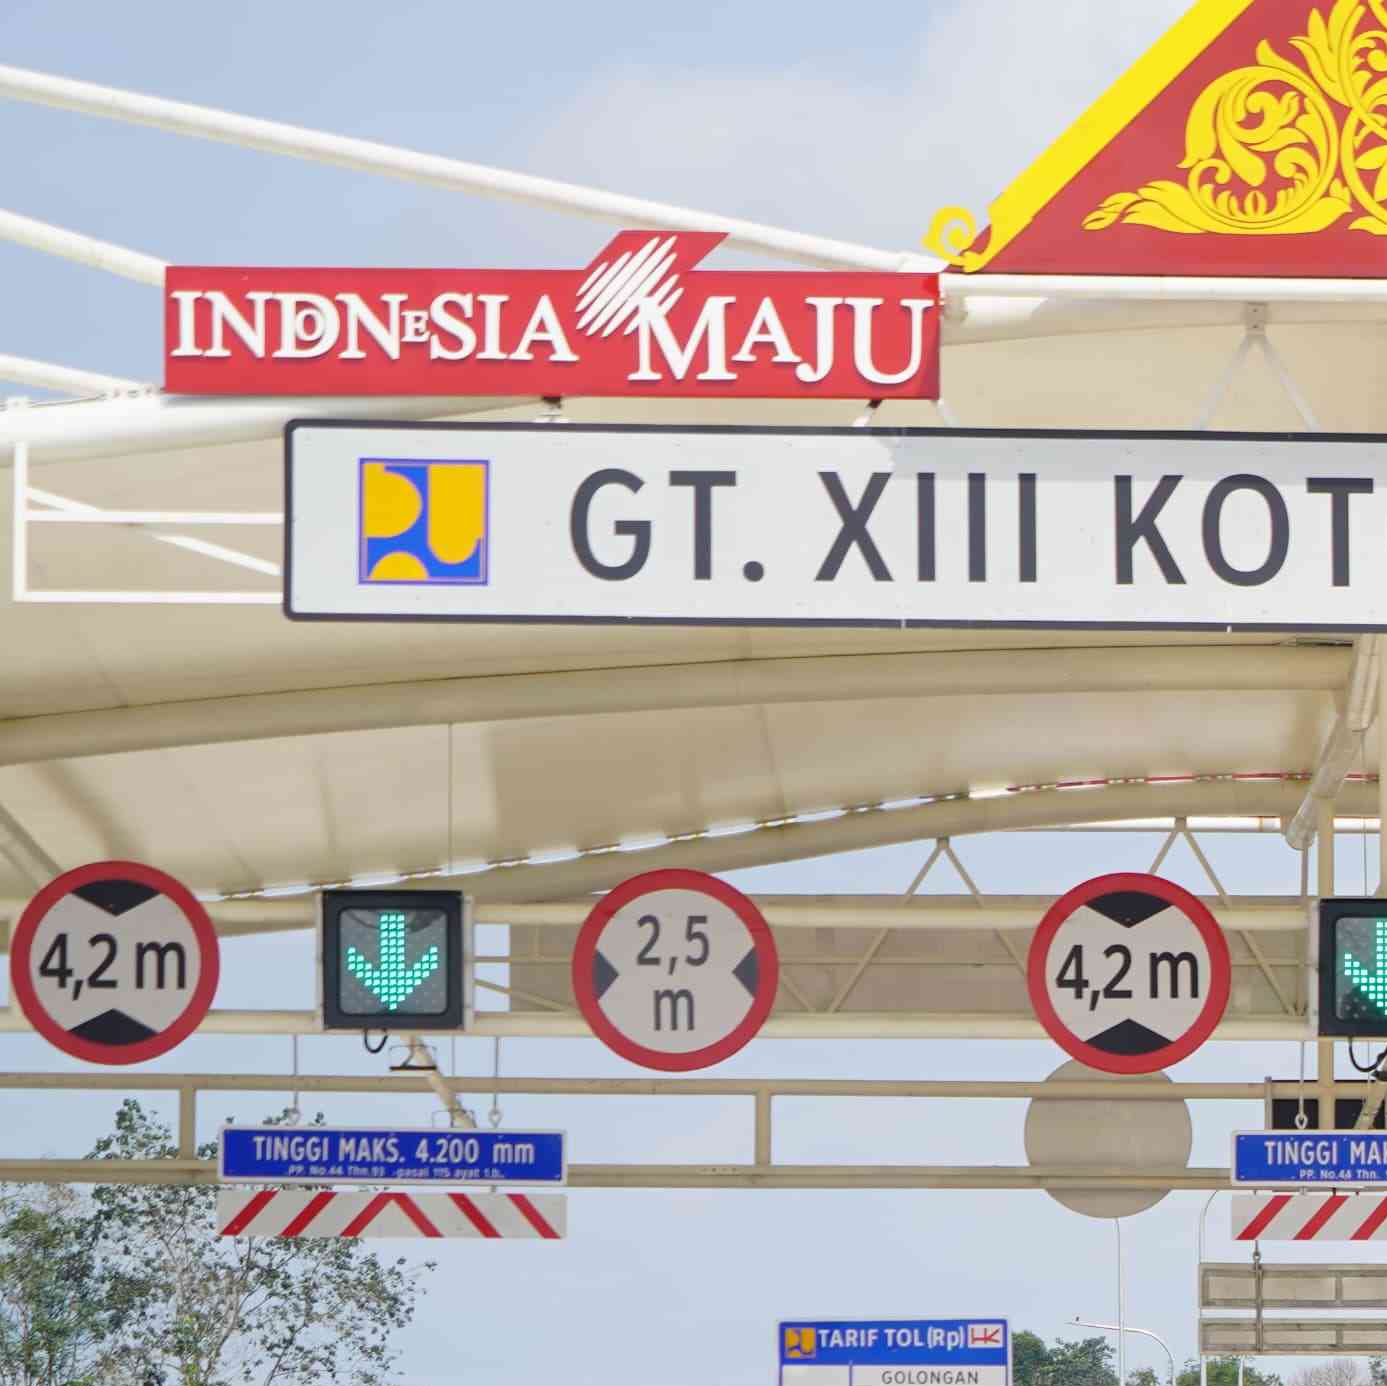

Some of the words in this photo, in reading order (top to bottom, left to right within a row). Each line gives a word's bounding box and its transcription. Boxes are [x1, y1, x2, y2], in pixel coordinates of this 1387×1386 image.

[627, 294, 935, 386] MAJU
[569, 467, 764, 583] GT.
[815, 470, 1037, 585] XIII
[39, 934, 117, 1000] 4,2
[134, 941, 187, 990] m
[636, 915, 710, 975] 2,5
[1055, 943, 1133, 1011] 4,2
[1149, 950, 1200, 1000] m
[653, 987, 695, 1031] m
[253, 1136, 329, 1161] TINGGI
[338, 1138, 405, 1162] MAKS.
[415, 1139, 479, 1163] 4.200
[493, 1143, 535, 1164] mm
[1264, 1140, 1337, 1165] TINGGI
[818, 1328, 878, 1347] TARIF
[884, 1328, 923, 1347] TOL
[927, 1325, 966, 1351] (Rp)
[881, 1370, 979, 1385] GOLONGAN
